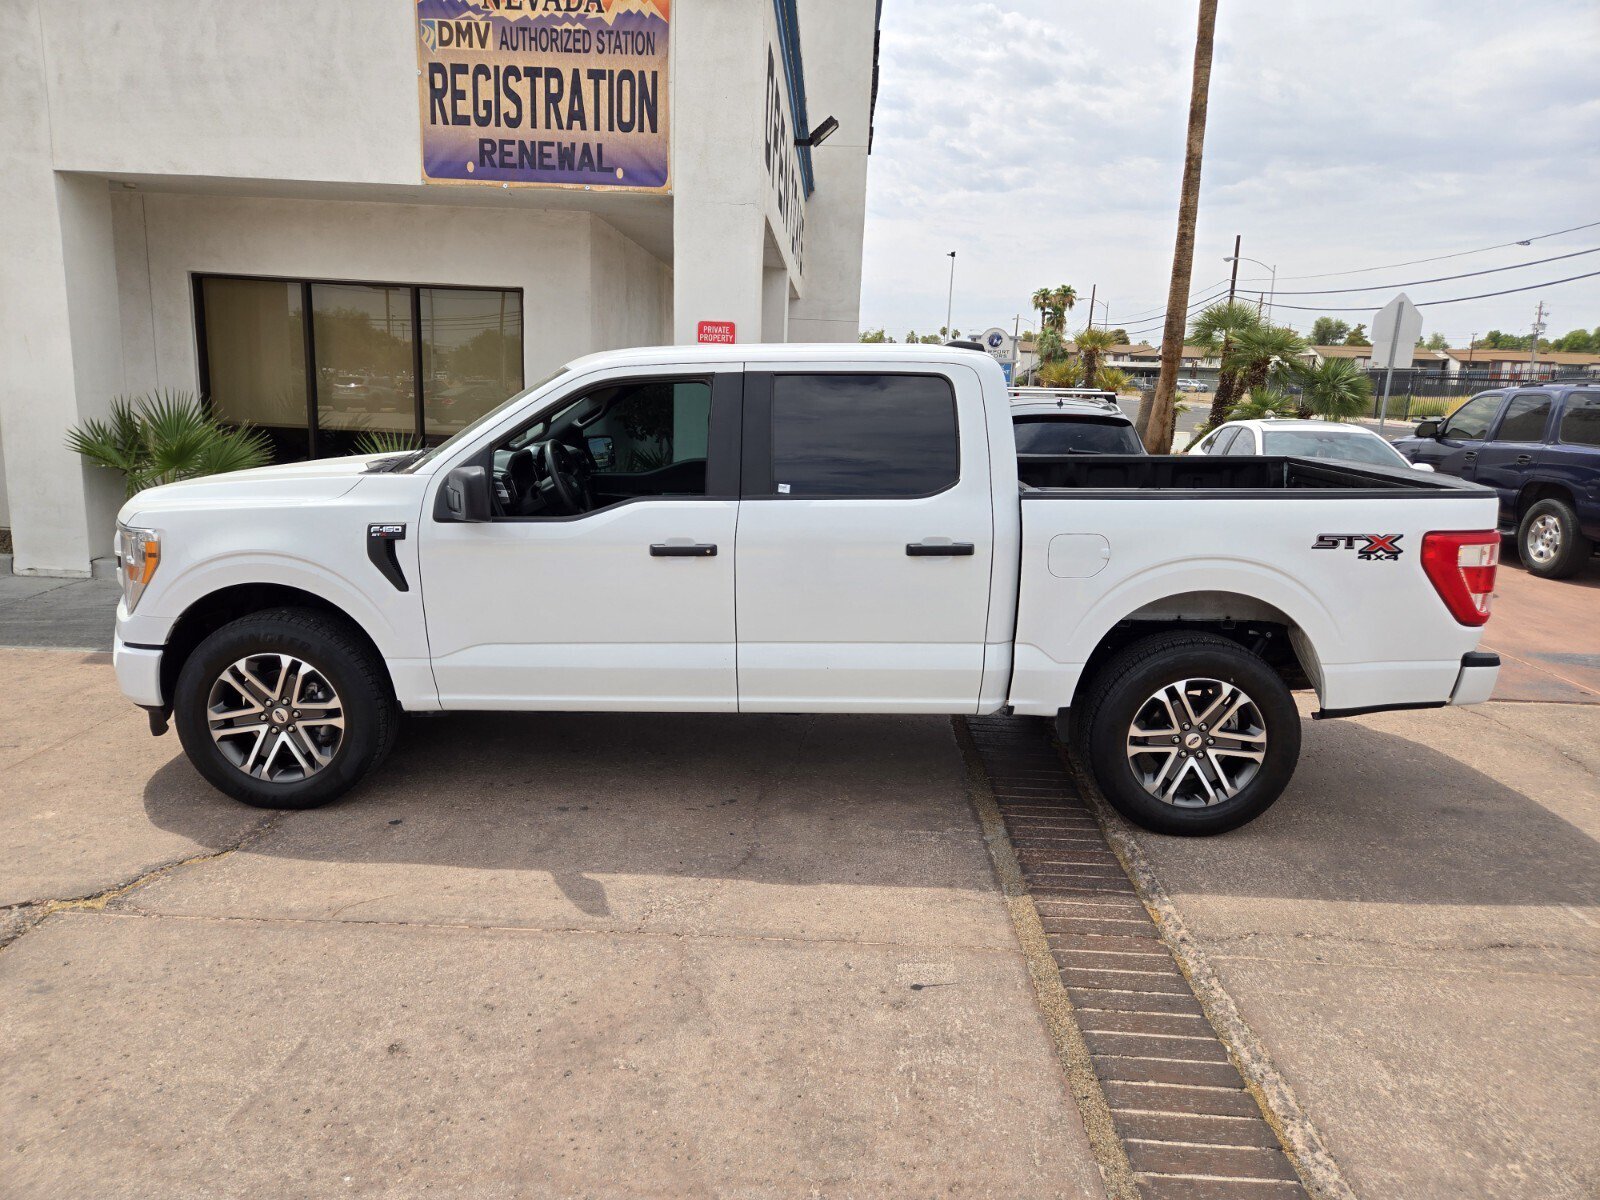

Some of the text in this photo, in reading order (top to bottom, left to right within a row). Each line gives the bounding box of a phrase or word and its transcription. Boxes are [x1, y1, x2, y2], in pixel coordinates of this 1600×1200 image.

[437, 20, 656, 56] DMV AUTHORIZED STATION
[428, 62, 658, 134] REGISTRATION
[765, 41, 790, 233] OPEN
[478, 138, 614, 173] RENEWAL
[699, 333, 734, 343] PROPERTY
[703, 325, 730, 334] PRIVATE
[1311, 533, 1404, 554] STX
